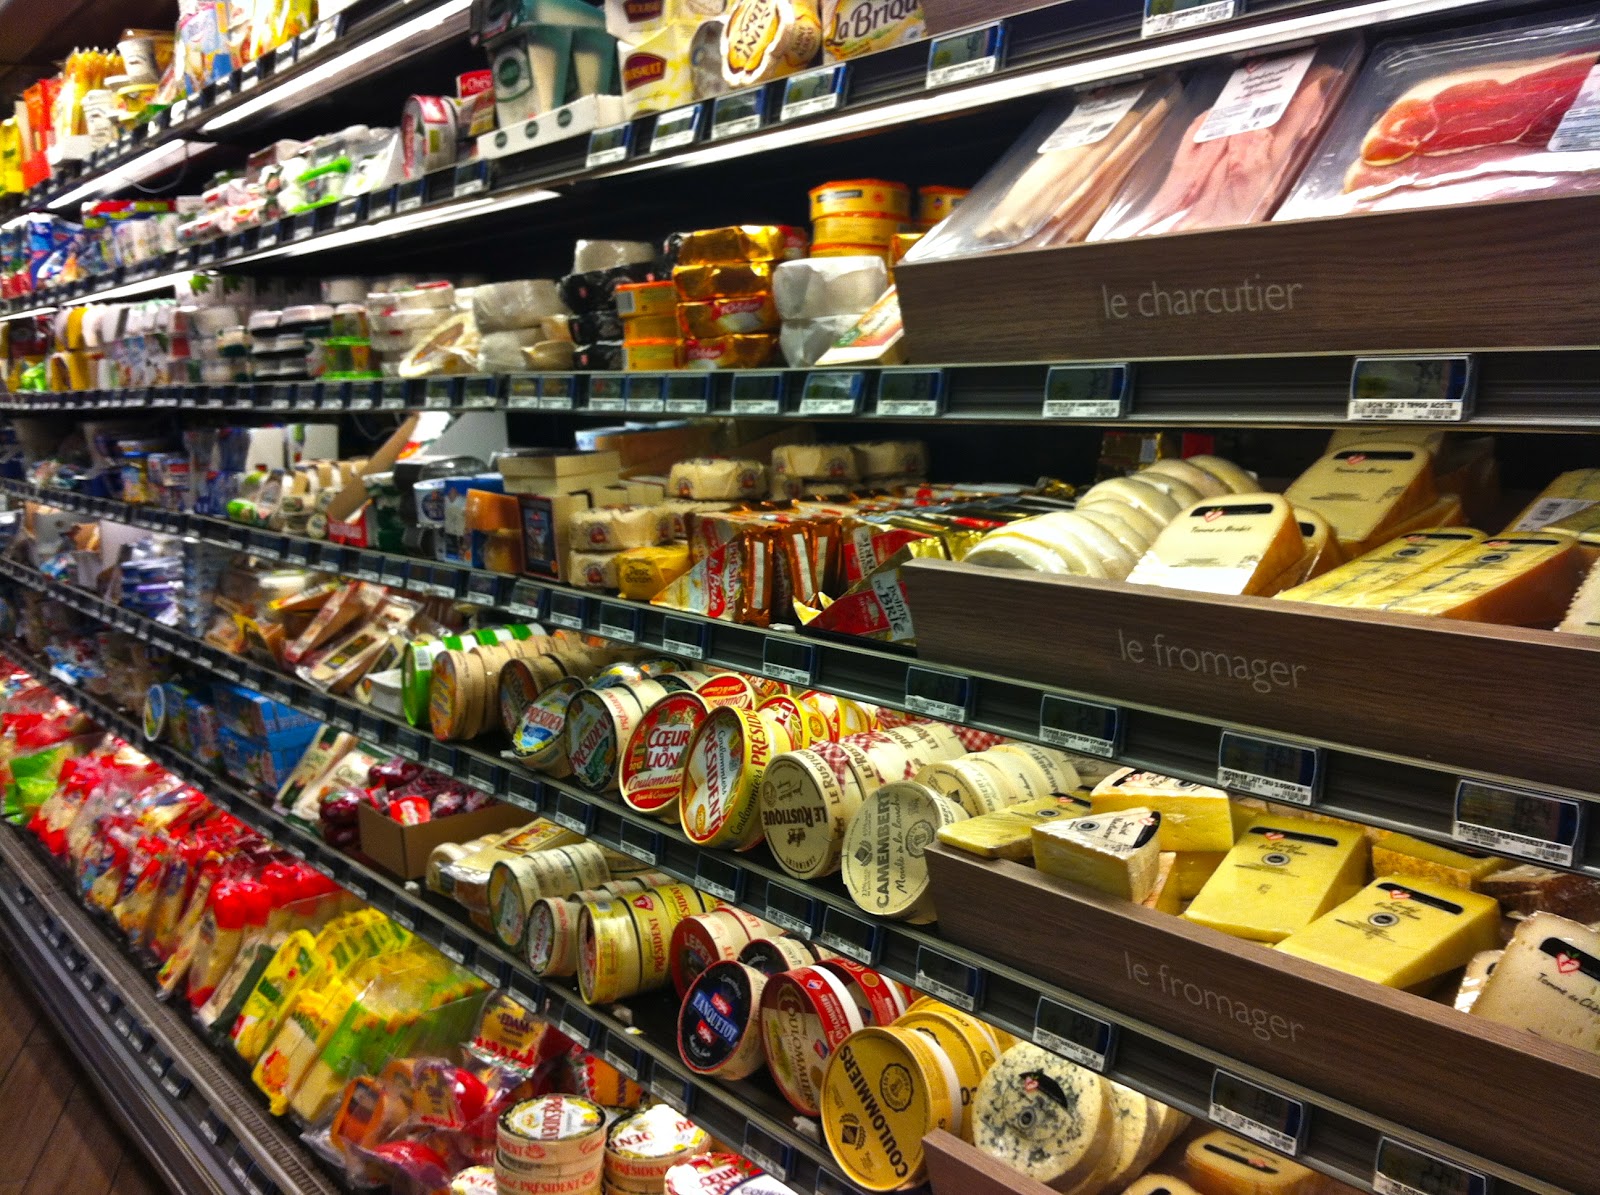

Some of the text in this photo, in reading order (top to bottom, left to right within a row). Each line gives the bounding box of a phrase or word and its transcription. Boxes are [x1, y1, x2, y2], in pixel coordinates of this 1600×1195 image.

[851, 1, 918, 39] Briqu
[1101, 273, 1303, 319] le charcutier
[1118, 628, 1307, 694] le fromager
[648, 727, 692, 748] CŒUR
[628, 773, 682, 792] Coulommie
[830, 791, 841, 805] LE
[763, 805, 814, 828] RUSTIQUE
[876, 790, 891, 908] CAMEMBERT
[692, 991, 738, 1042] LANQUETOT
[1124, 951, 1305, 1042] le fromager
[838, 1045, 909, 1178] COULOMMIERS
